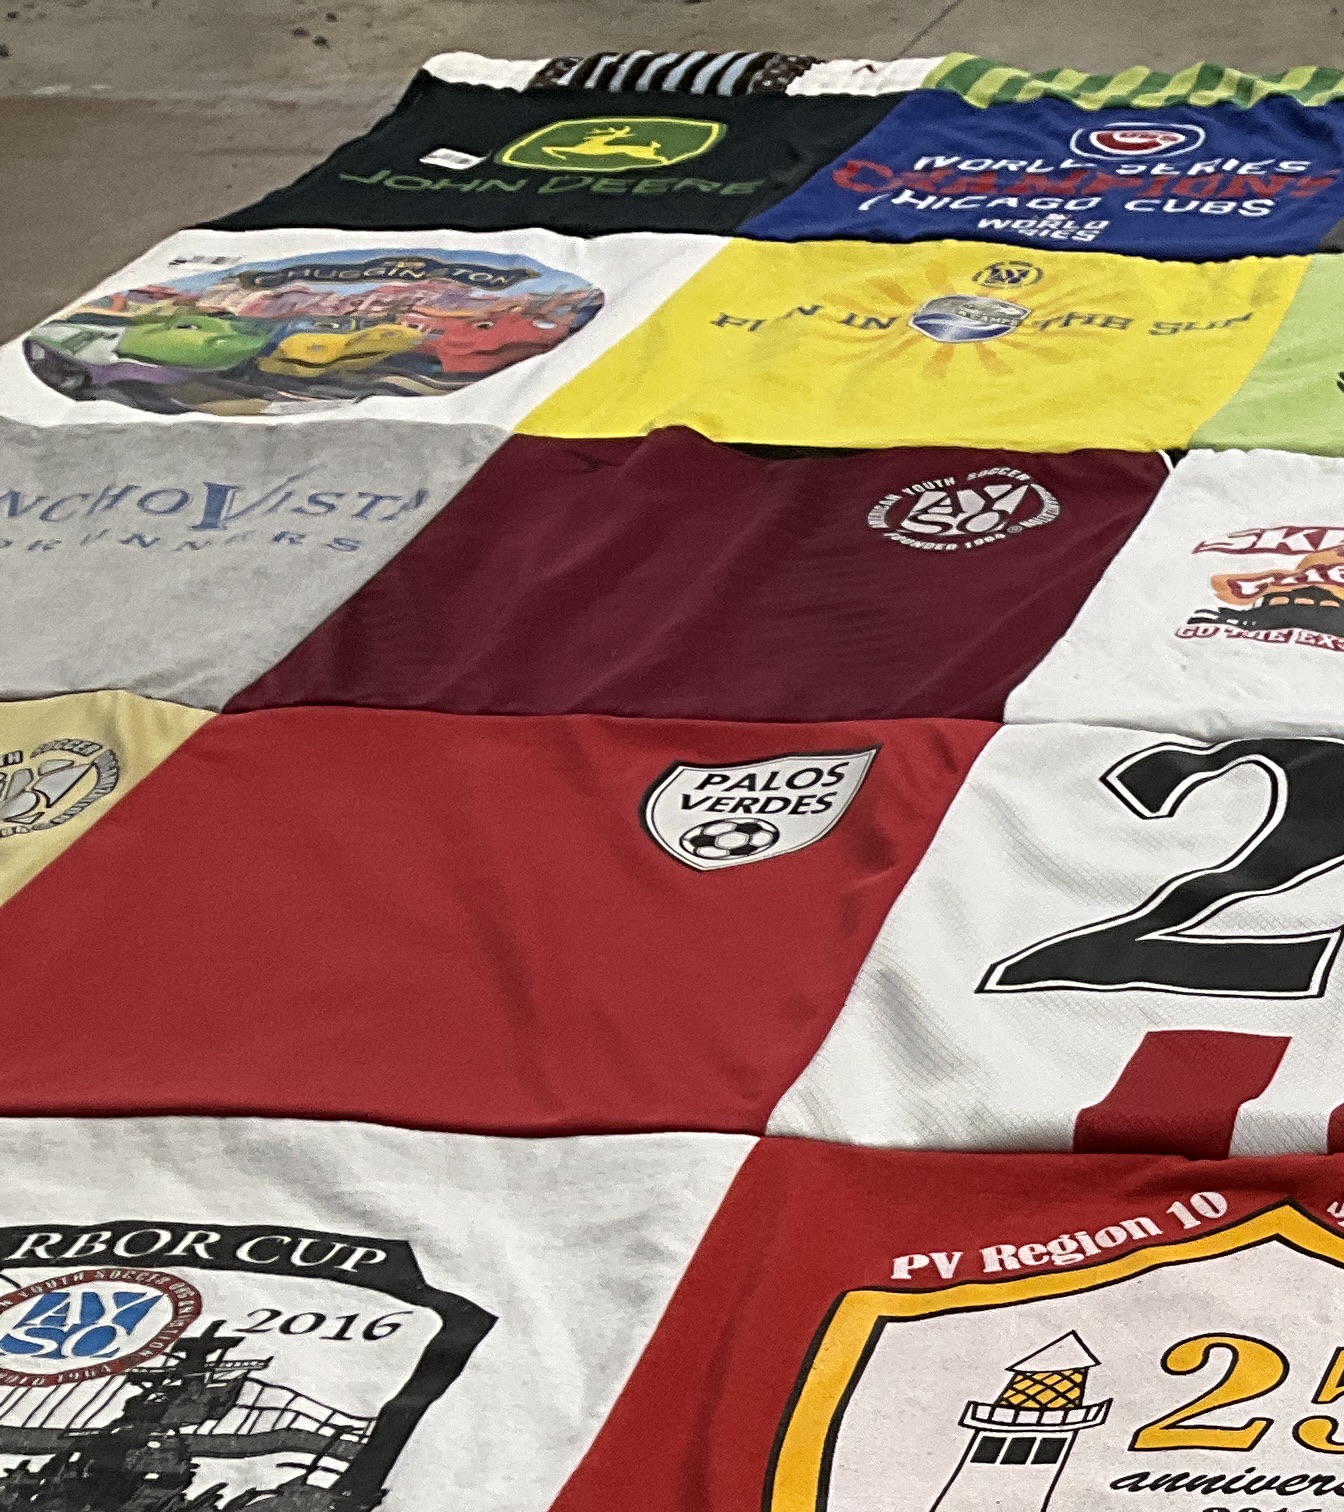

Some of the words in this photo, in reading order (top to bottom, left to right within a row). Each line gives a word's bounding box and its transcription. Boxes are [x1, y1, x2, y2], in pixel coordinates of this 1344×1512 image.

[338, 168, 525, 194] JOHN
[539, 172, 763, 197] DEERE
[1124, 198, 1276, 218] CUBS
[837, 312, 899, 330] IN
[694, 762, 849, 792] PALOS
[681, 791, 838, 815] VERDES
[890, 1250, 963, 1280] PV
[981, 1216, 1163, 1274] Region
[1166, 1190, 1230, 1230] 10
[235, 1234, 388, 1275] CUP
[234, 1307, 415, 1342] 2016
